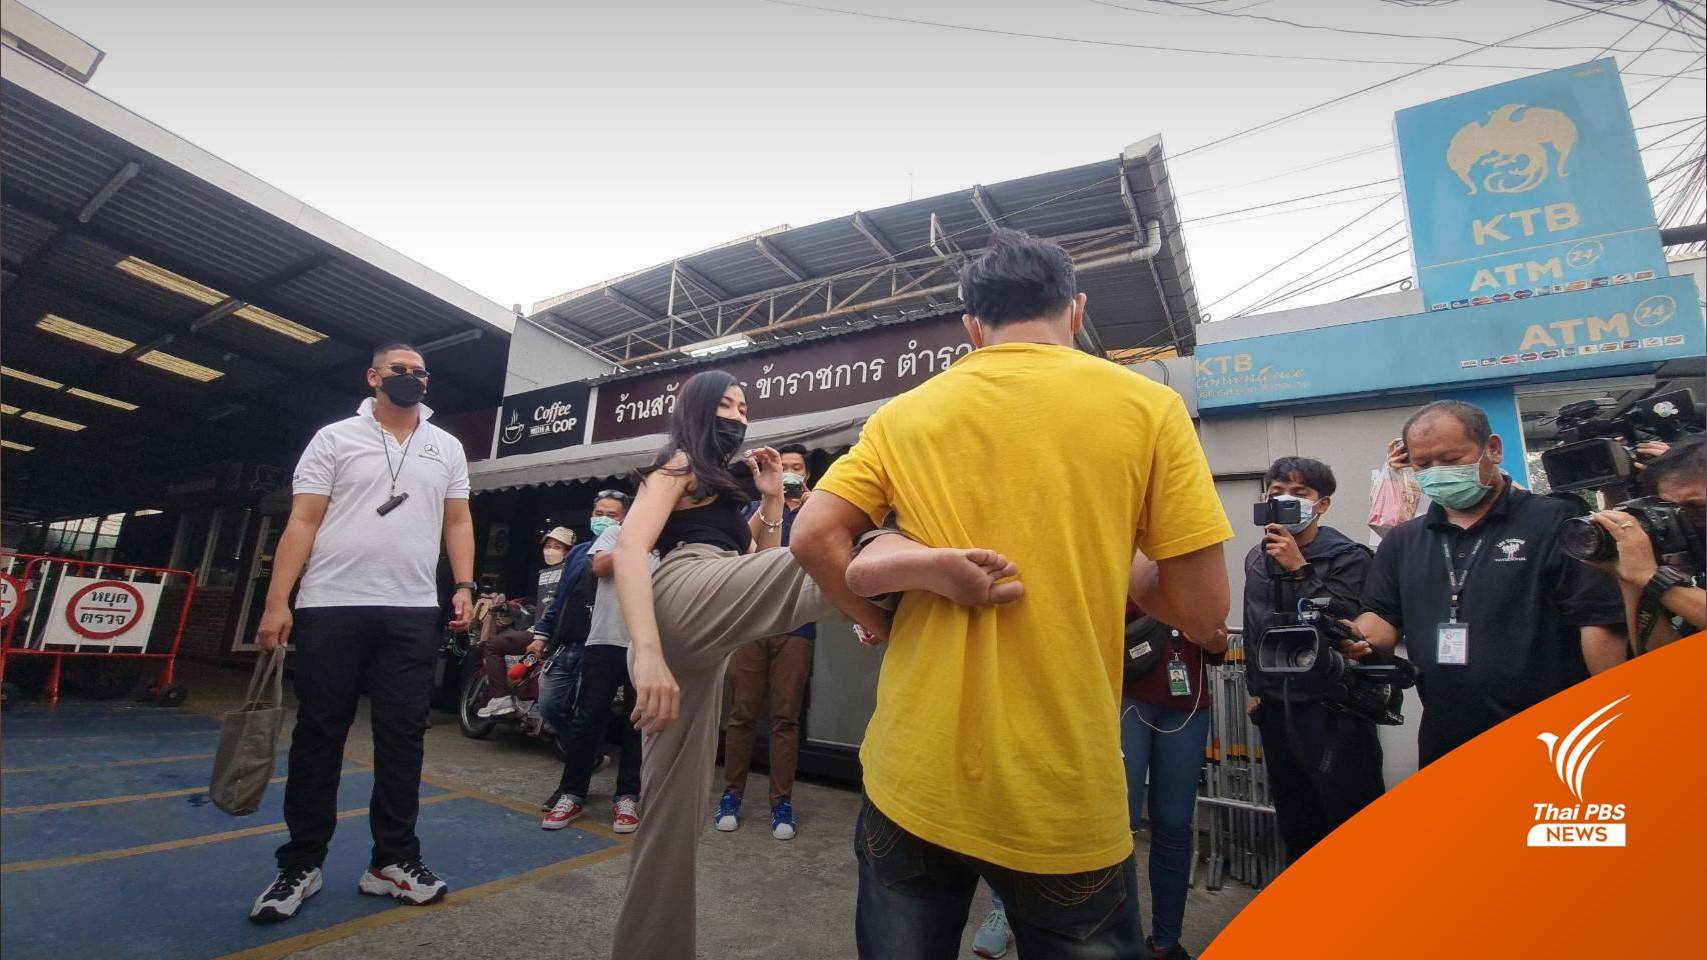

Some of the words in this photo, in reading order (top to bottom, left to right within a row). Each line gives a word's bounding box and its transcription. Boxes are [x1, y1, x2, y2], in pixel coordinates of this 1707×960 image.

[1471, 202, 1580, 246] KTB
[1469, 256, 1563, 292] ATM
[1571, 248, 1595, 264] 24
[1519, 312, 1630, 351] ATM
[1639, 304, 1666, 319] 24
[1195, 352, 1254, 376] KTB
[615, 382, 680, 423] ร้านสวั
[756, 363, 886, 399] ข้าราชการ
[534, 401, 573, 423] Coffee
[552, 418, 577, 433] COP
[91, 591, 129, 607] หยุด
[80, 613, 126, 625] ตรวจ
